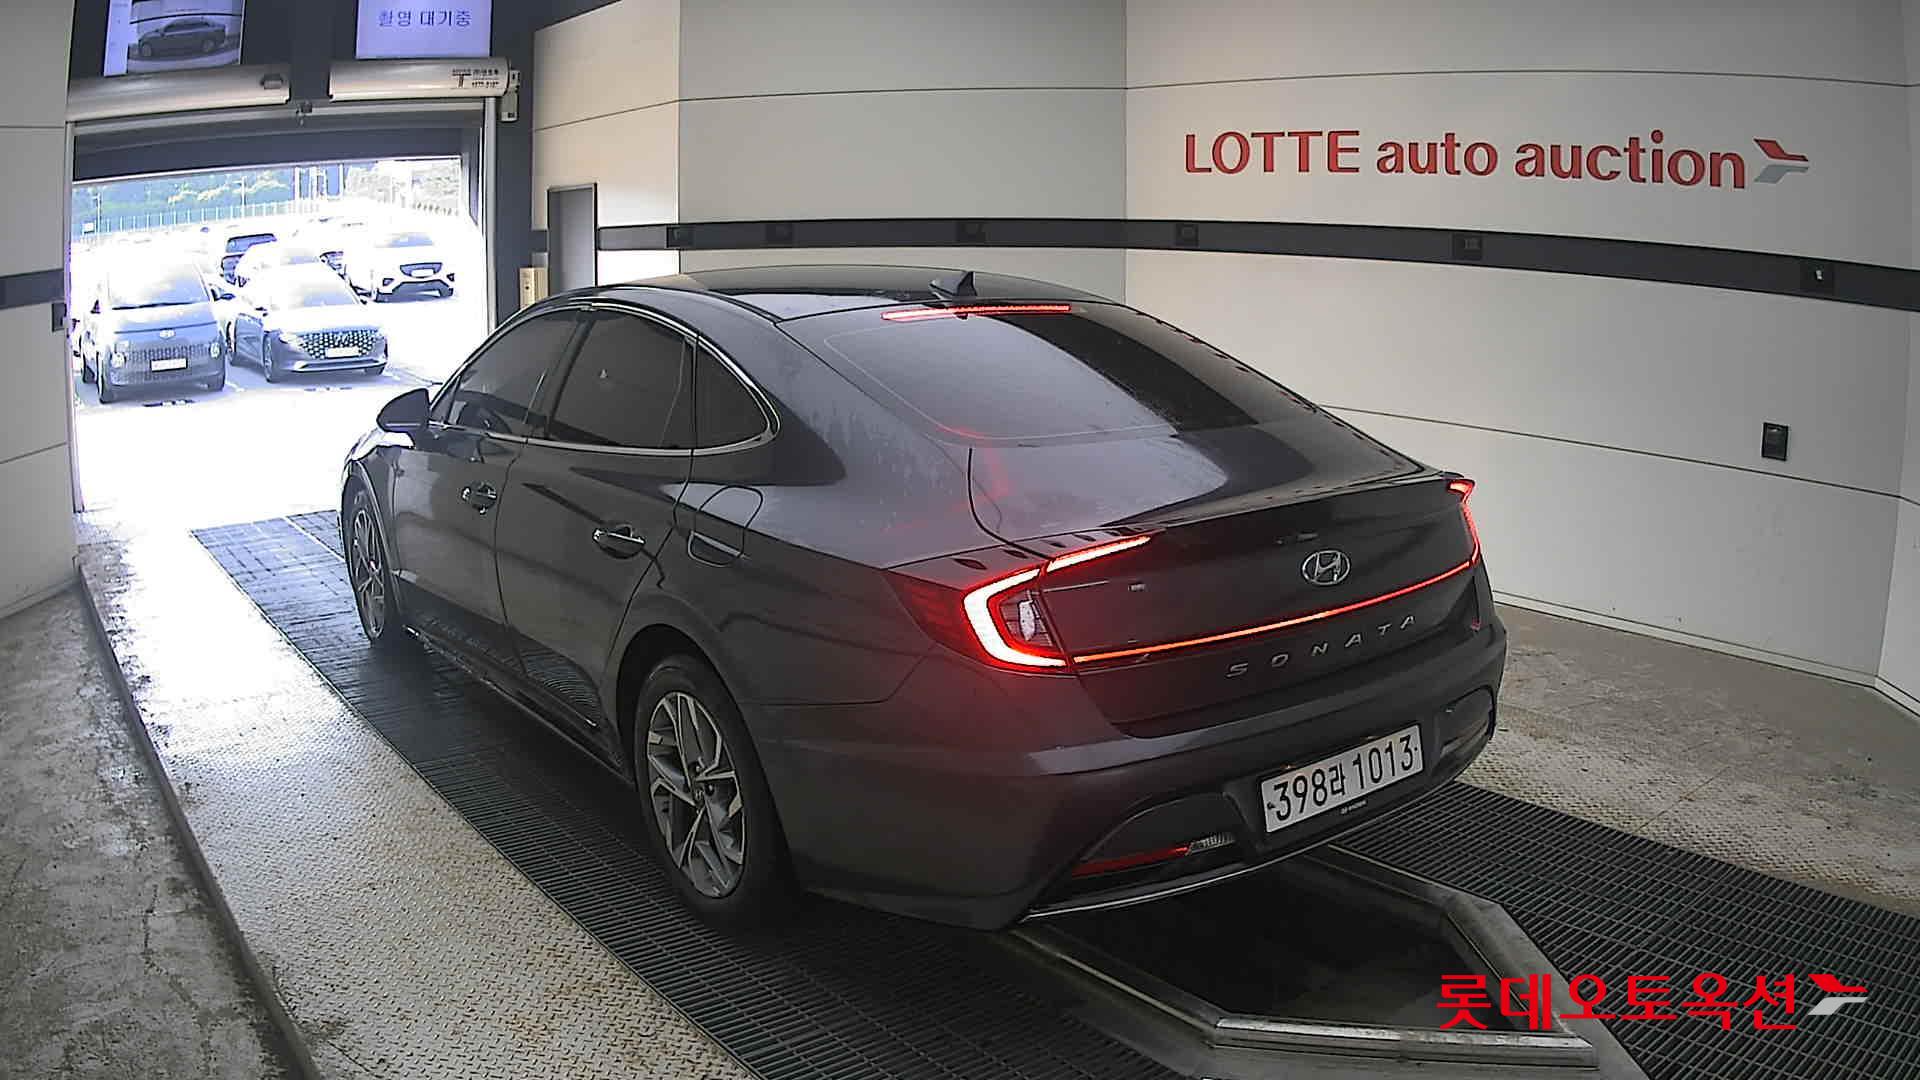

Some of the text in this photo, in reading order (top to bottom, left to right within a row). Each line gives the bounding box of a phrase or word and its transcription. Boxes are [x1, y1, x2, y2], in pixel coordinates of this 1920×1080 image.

[420, 10, 472, 27] 대기중
[1184, 129, 1745, 189] LOTTE auto auction
[1226, 614, 1416, 678] SONATA
[1273, 734, 1413, 822] 398라 1013
